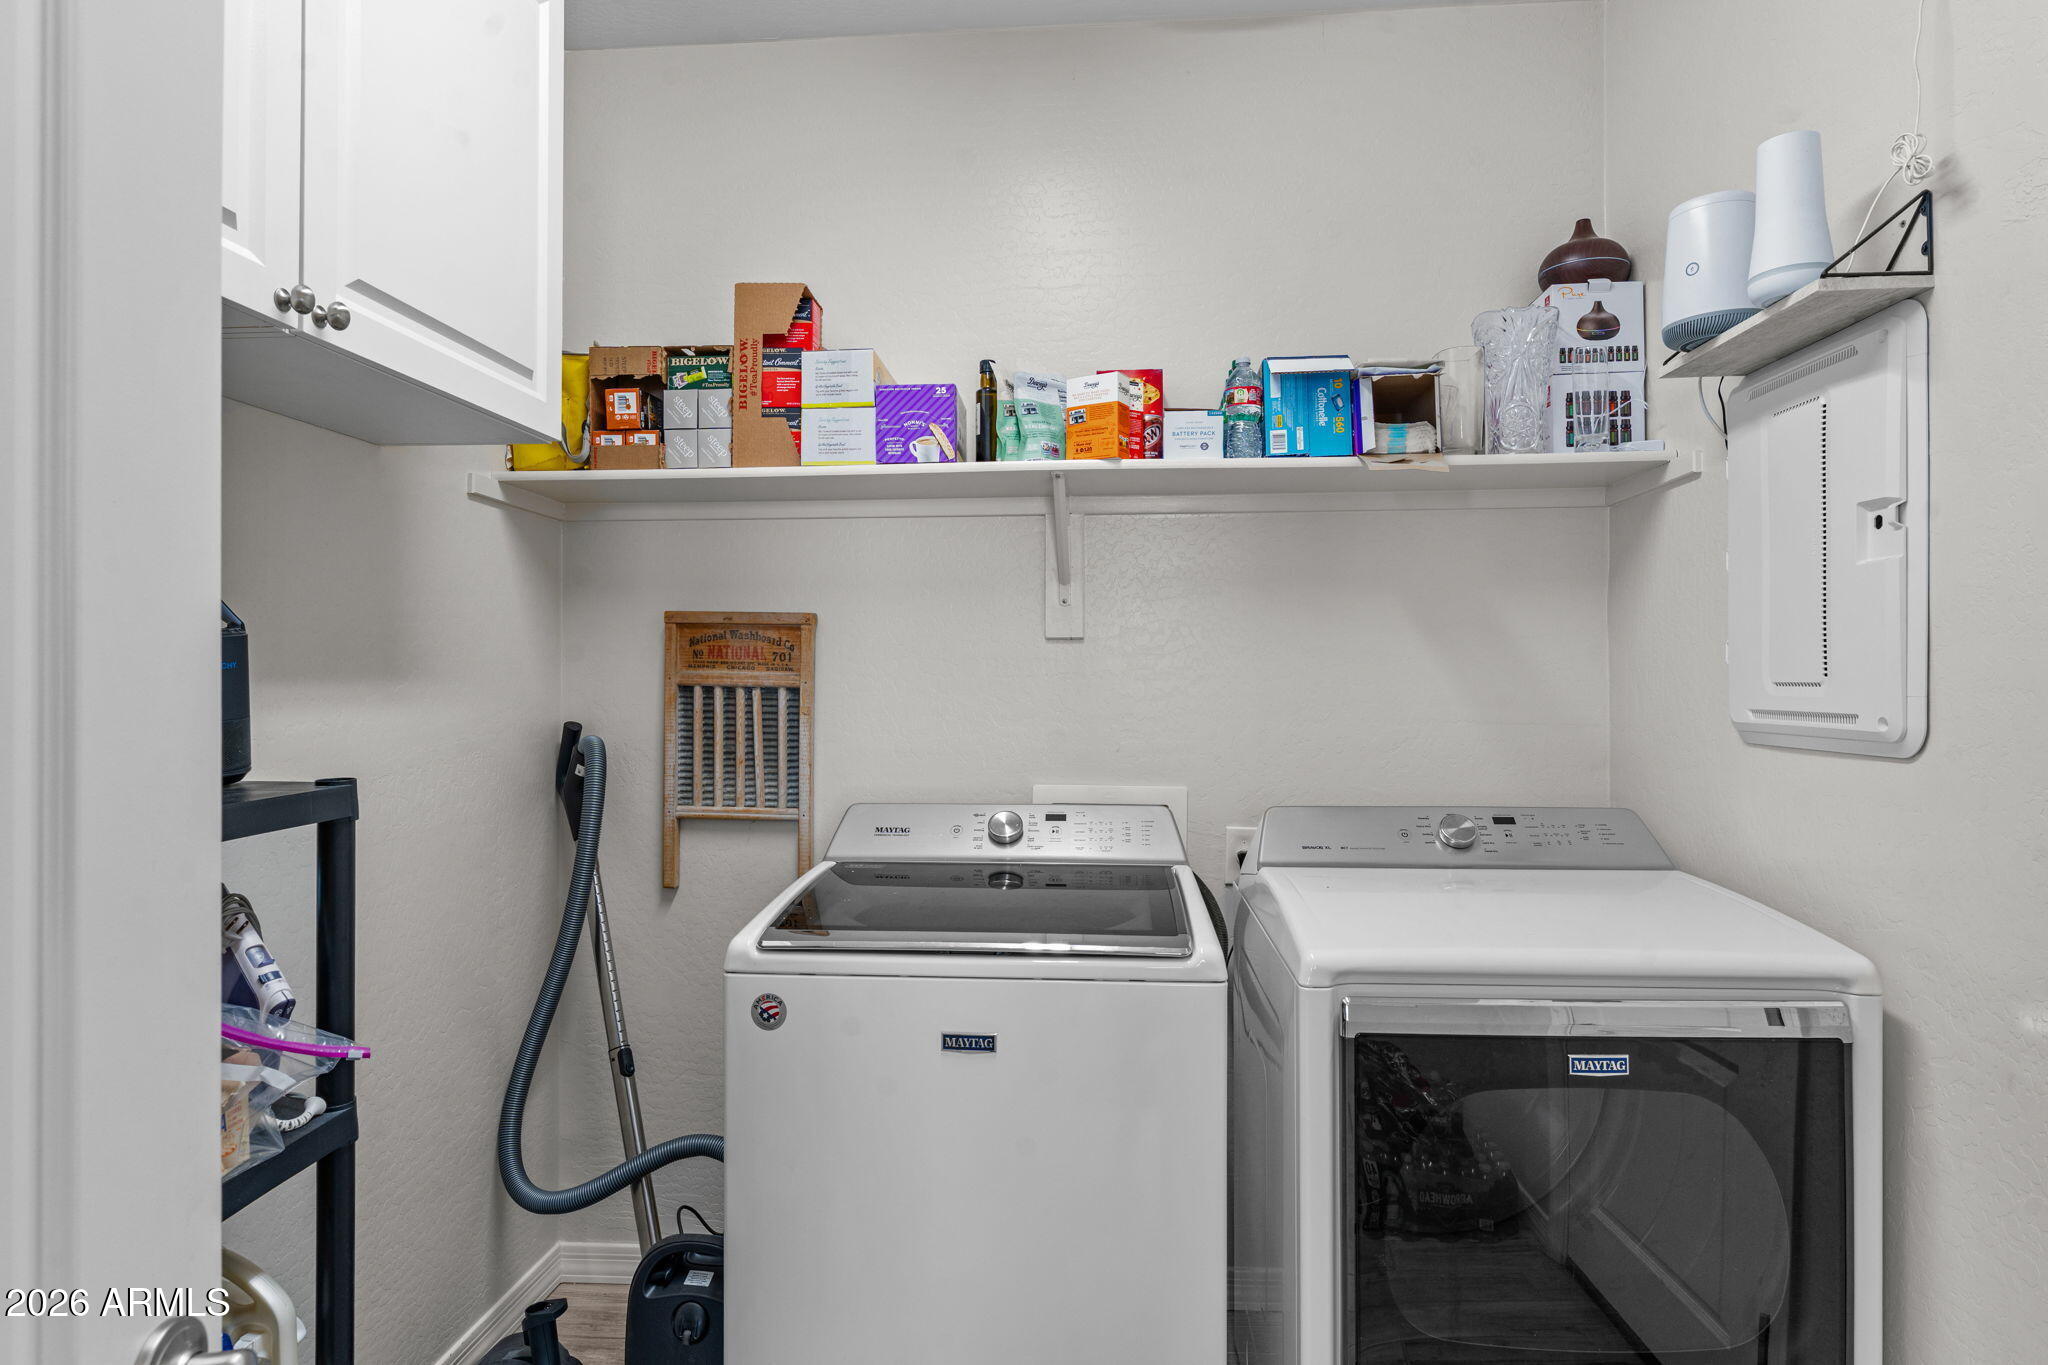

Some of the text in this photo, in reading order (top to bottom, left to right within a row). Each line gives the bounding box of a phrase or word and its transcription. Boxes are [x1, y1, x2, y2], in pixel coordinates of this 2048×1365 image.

[750, 338, 759, 397] #TeaProudly
[935, 386, 947, 394] 25
[1332, 378, 1343, 389] 10
[673, 395, 694, 419] steep
[707, 395, 728, 419] steep
[1317, 387, 1328, 427] Cottonelle
[673, 435, 695, 458] steep
[707, 435, 728, 458] steep
[688, 630, 727, 648] National
[729, 629, 782, 647] Washboard
[707, 644, 767, 661] NATIONAL
[772, 651, 793, 663] 701
[875, 826, 911, 834] MAYTAG
[753, 994, 783, 1010] AMERICA
[944, 1037, 994, 1049] MAYTAG
[1572, 1060, 1627, 1072] MAYTAG
